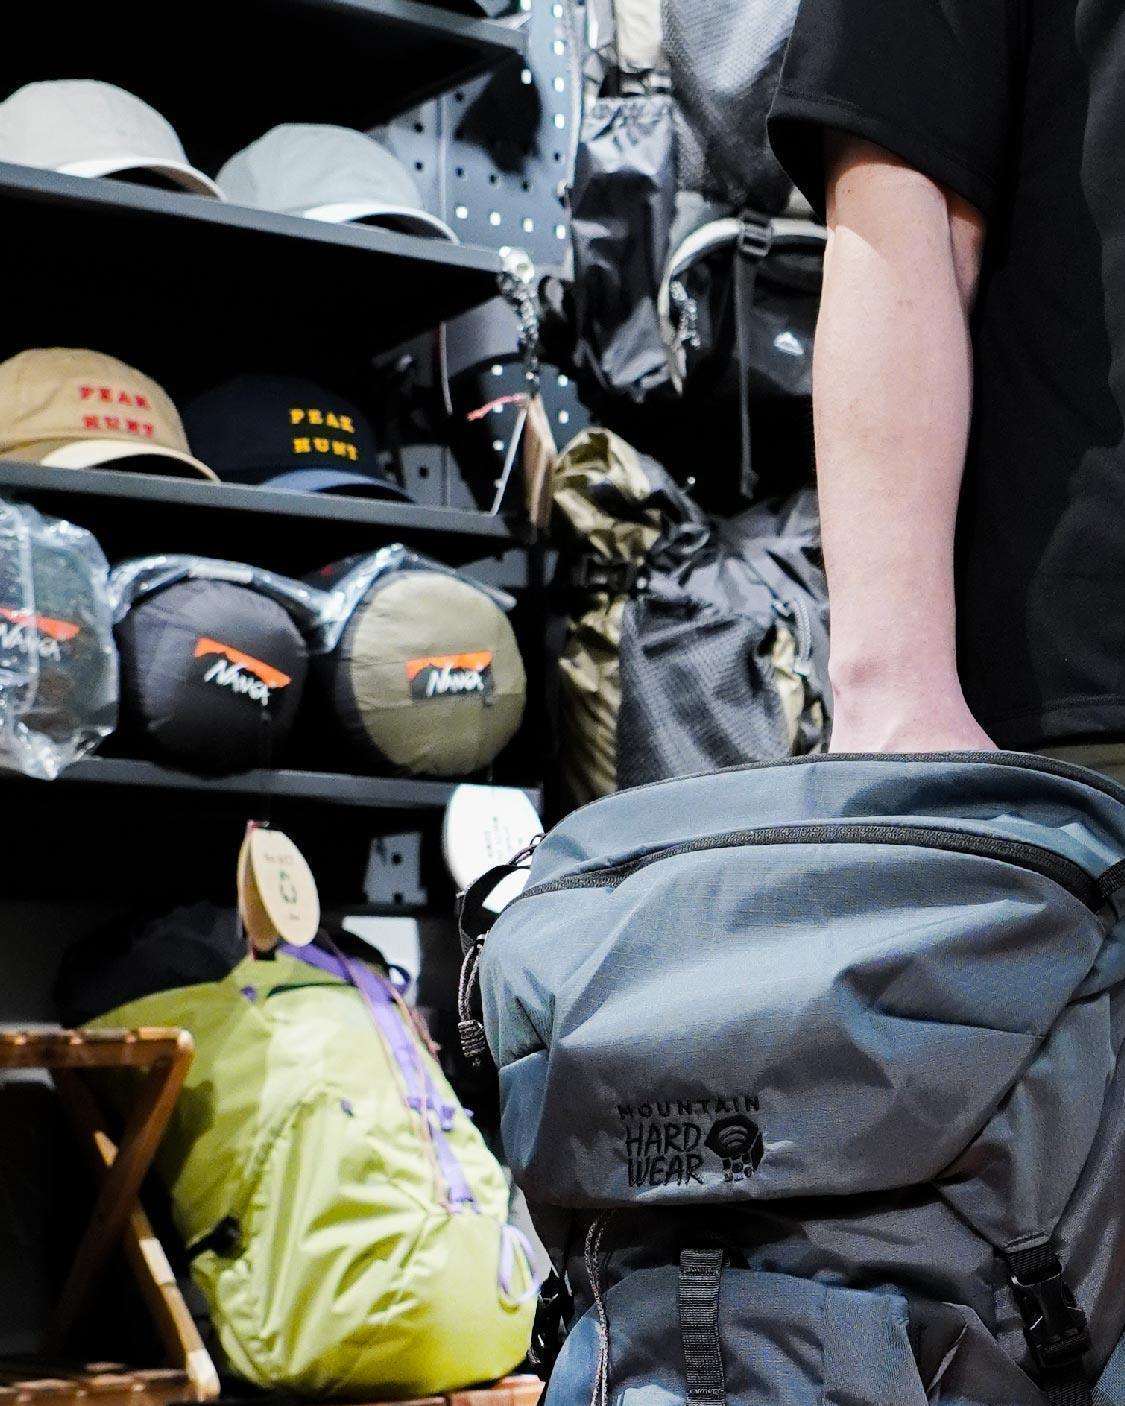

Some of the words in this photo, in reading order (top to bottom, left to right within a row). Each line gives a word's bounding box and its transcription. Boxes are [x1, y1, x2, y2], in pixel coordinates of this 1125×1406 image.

[289, 408, 356, 434] PEAK
[615, 1095, 761, 1121] MOUNTAIN
[624, 1121, 702, 1156] HARD
[626, 1152, 705, 1187] WEAR
